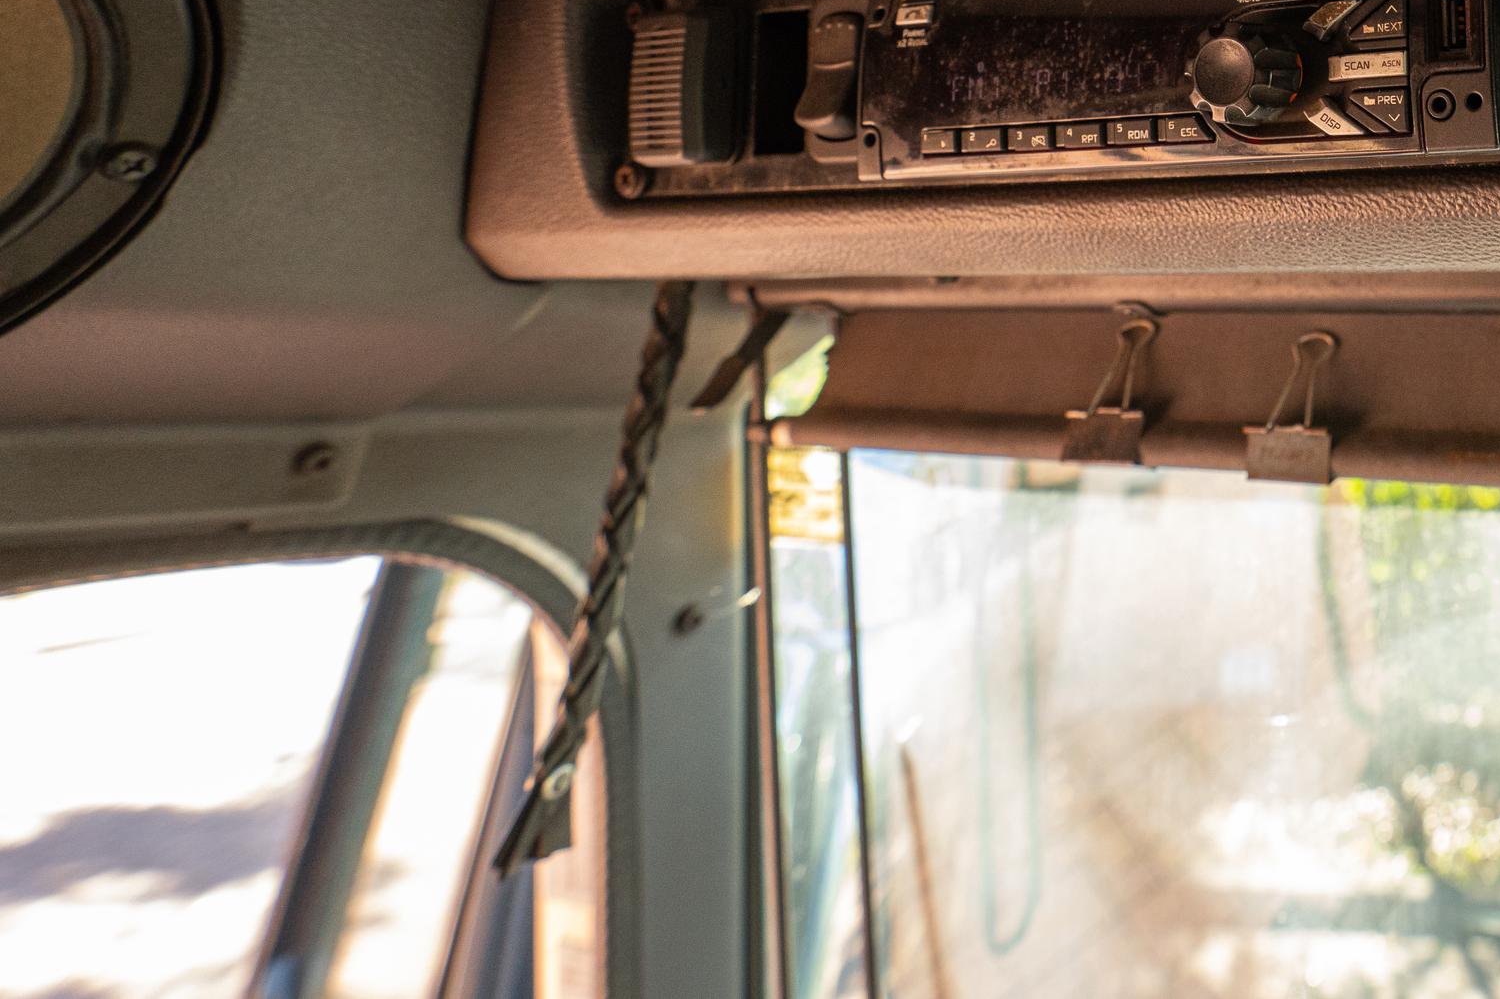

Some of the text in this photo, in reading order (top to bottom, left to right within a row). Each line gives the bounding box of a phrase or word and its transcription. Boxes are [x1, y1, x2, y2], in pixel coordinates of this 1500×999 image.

[1377, 21, 1403, 32] NEXT
[1344, 60, 1401, 71] SCAN ASCN
[1377, 95, 1404, 106] PREV
[1319, 113, 1342, 130] DISP
[1116, 123, 1149, 140] 5 RDM
[1168, 121, 1198, 137] 6 ESC
[969, 132, 976, 141] 2
[1016, 131, 1023, 140] 3
[1066, 128, 1098, 144] 4 RPT
